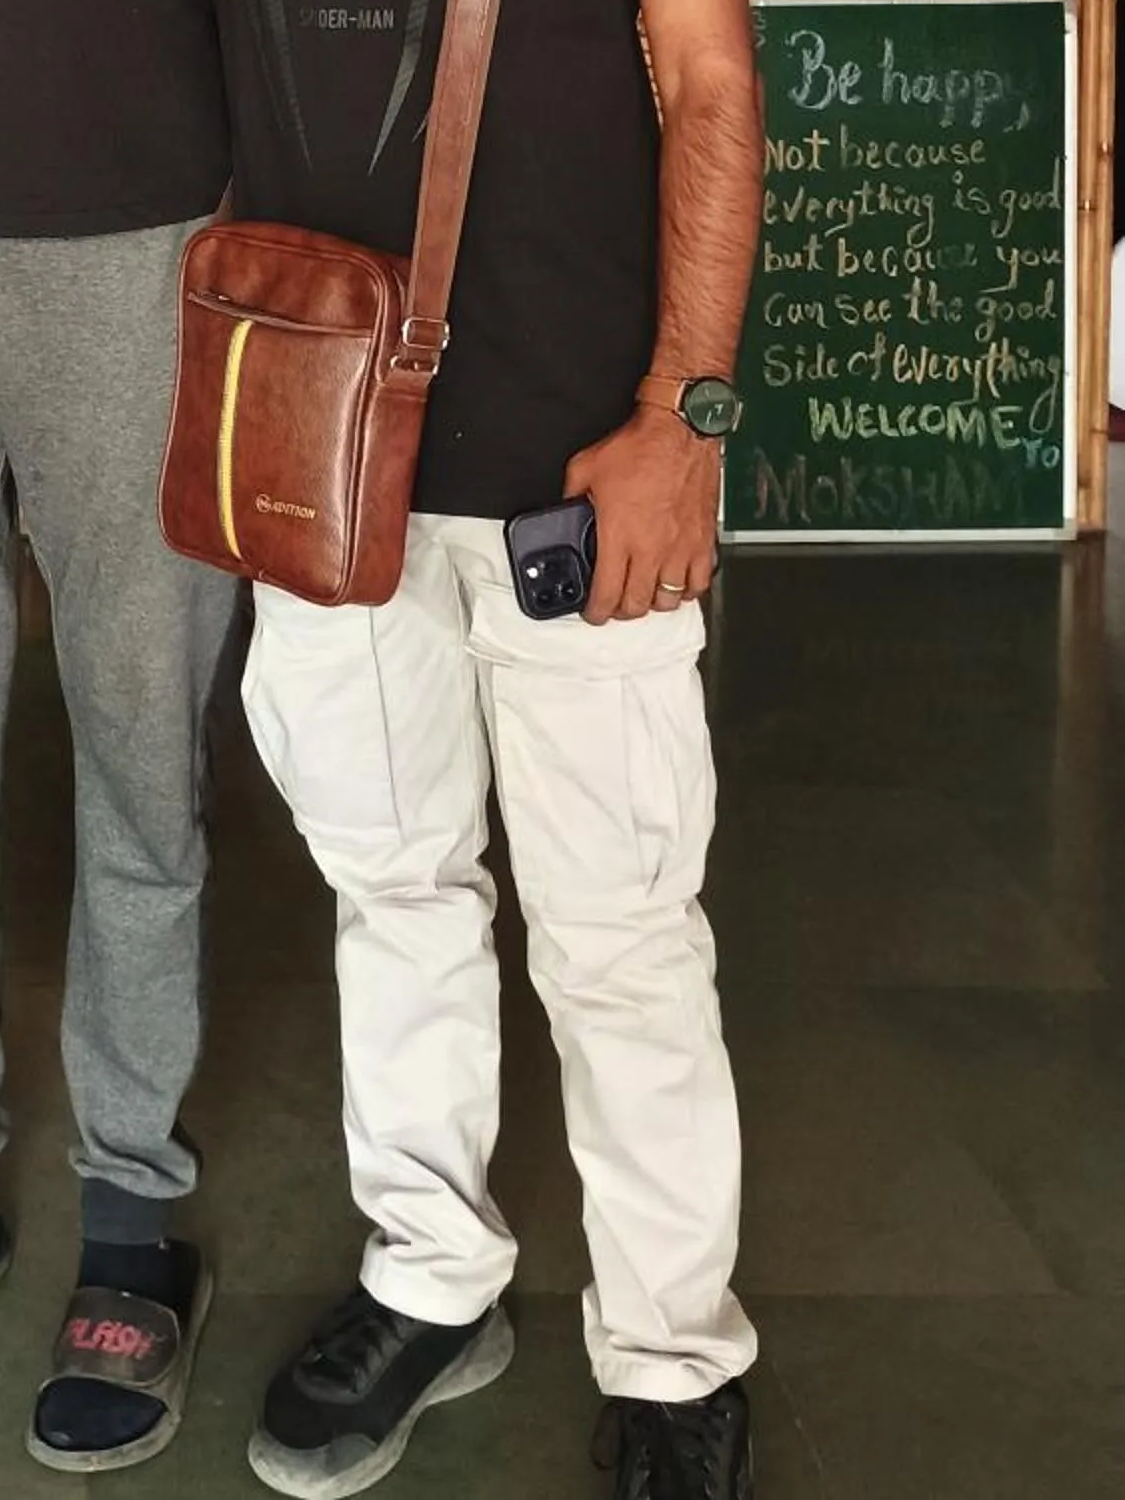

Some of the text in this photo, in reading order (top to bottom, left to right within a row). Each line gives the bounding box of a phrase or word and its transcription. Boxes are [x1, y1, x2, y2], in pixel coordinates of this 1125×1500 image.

[786, 30, 861, 109] Be
[763, 123, 986, 176] Not because
[763, 156, 1063, 247] everything is good
[764, 232, 824, 273] but
[979, 244, 1063, 291] you
[902, 276, 964, 327] the
[974, 278, 1057, 342] good
[848, 332, 888, 381] of
[891, 336, 1063, 435] everything
[807, 396, 1024, 450] WELCOME
